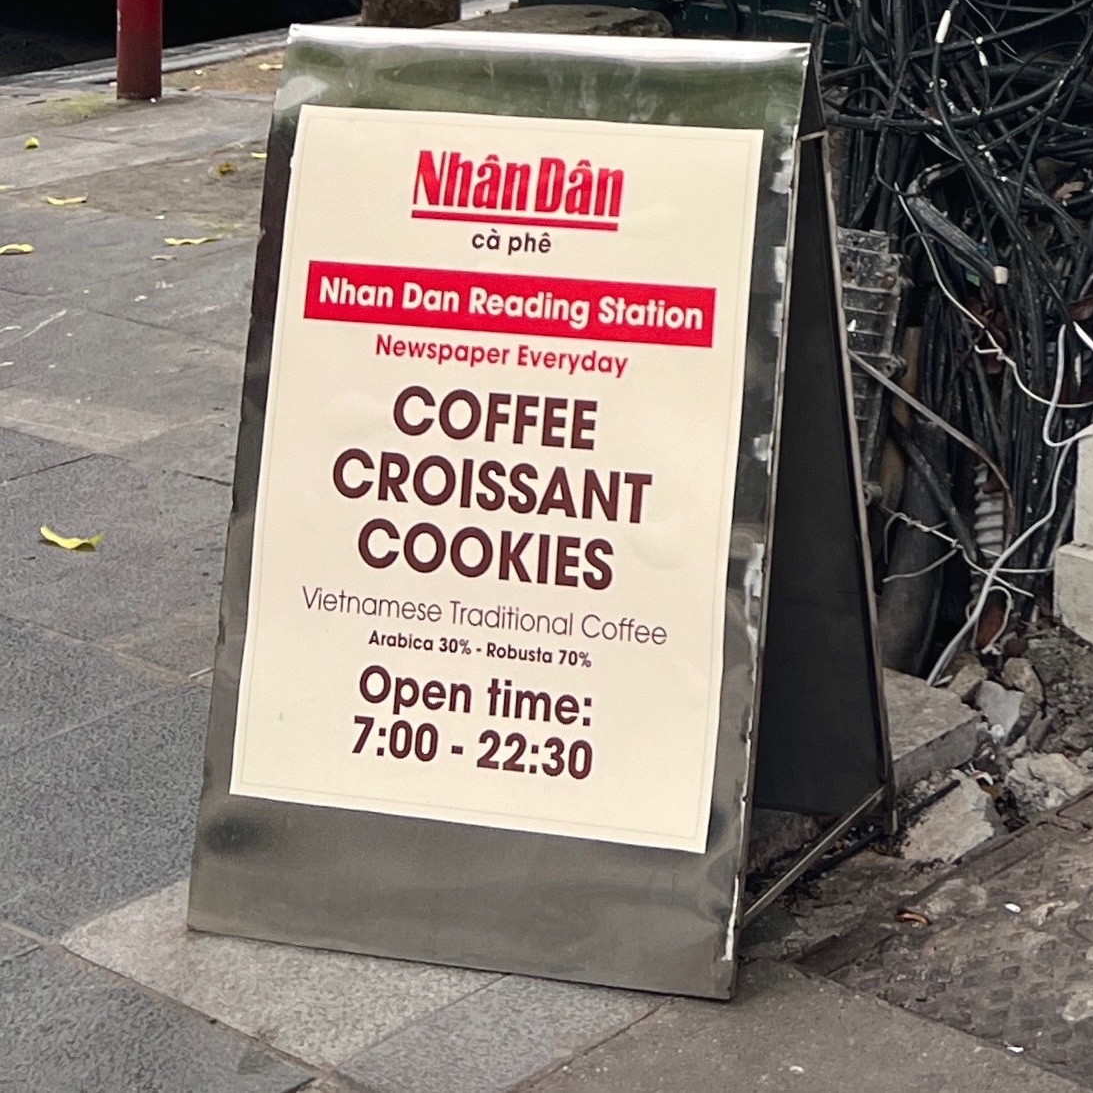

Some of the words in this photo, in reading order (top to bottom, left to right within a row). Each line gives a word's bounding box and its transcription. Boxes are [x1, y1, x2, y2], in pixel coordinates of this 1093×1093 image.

[413, 150, 531, 211] Nhân
[534, 157, 624, 217] Dân
[472, 228, 500, 250] cà
[508, 232, 552, 255] phê
[319, 276, 393, 308] Nhan
[402, 282, 459, 312] Dan
[468, 287, 589, 329] Reading
[598, 295, 703, 330] Station
[376, 334, 510, 367] Newspaper
[517, 345, 628, 378] Everyday
[393, 385, 598, 451] COFFEE
[332, 447, 653, 524] CROISSANT
[358, 518, 614, 590] COOKIES
[302, 586, 442, 623] Vietnamese
[450, 600, 573, 636] Traditional
[581, 613, 667, 645] Coffee
[368, 630, 433, 651] Arabica
[439, 637, 472, 656] 30%
[486, 642, 553, 664] Robusta
[558, 649, 592, 668] 70%
[359, 665, 471, 715] Open
[487, 678, 593, 726] time:
[352, 715, 438, 762] 7:00
[451, 745, 464, 755] -
[476, 729, 593, 780] 22:30
